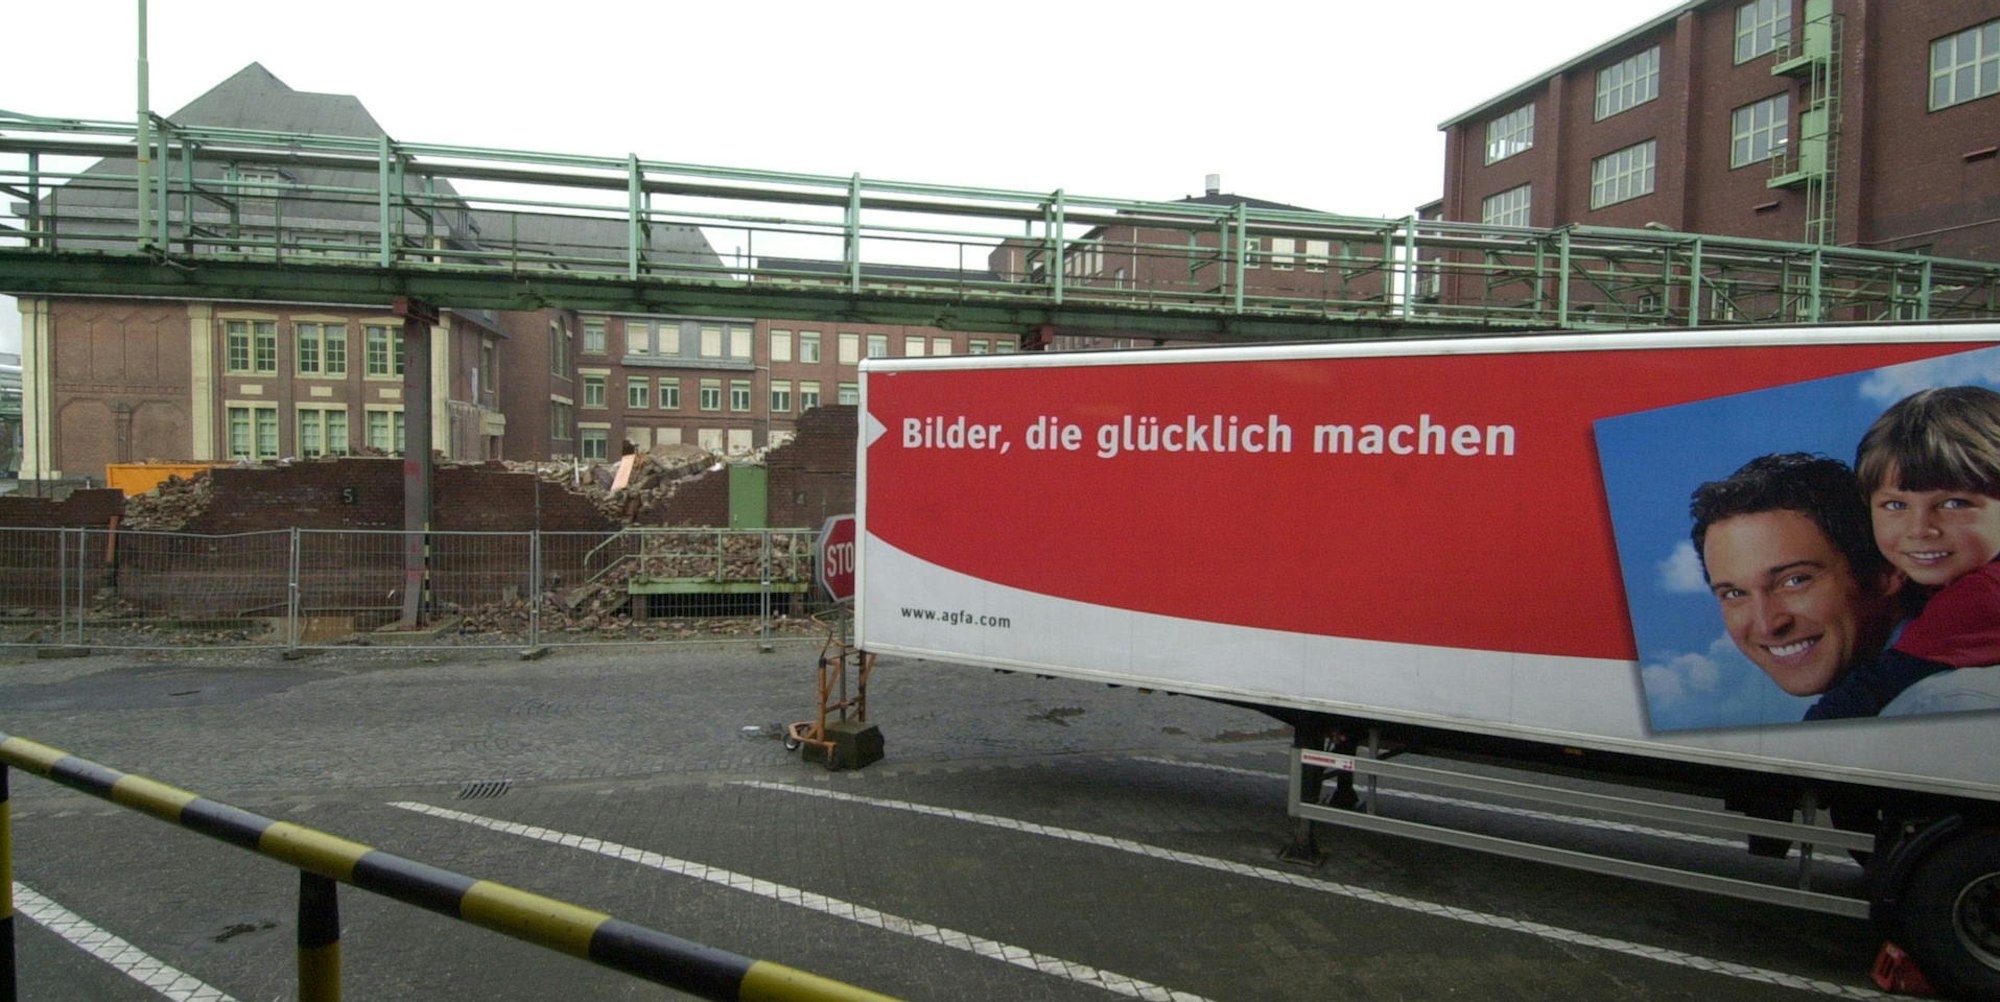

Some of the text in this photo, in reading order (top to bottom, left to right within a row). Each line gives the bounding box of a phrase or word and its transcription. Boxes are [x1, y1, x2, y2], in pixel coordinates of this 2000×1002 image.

[902, 413, 1516, 459] Bilder, die glücklich machen
[827, 541, 855, 577] STO
[901, 606, 1011, 628] www.agfa.com
